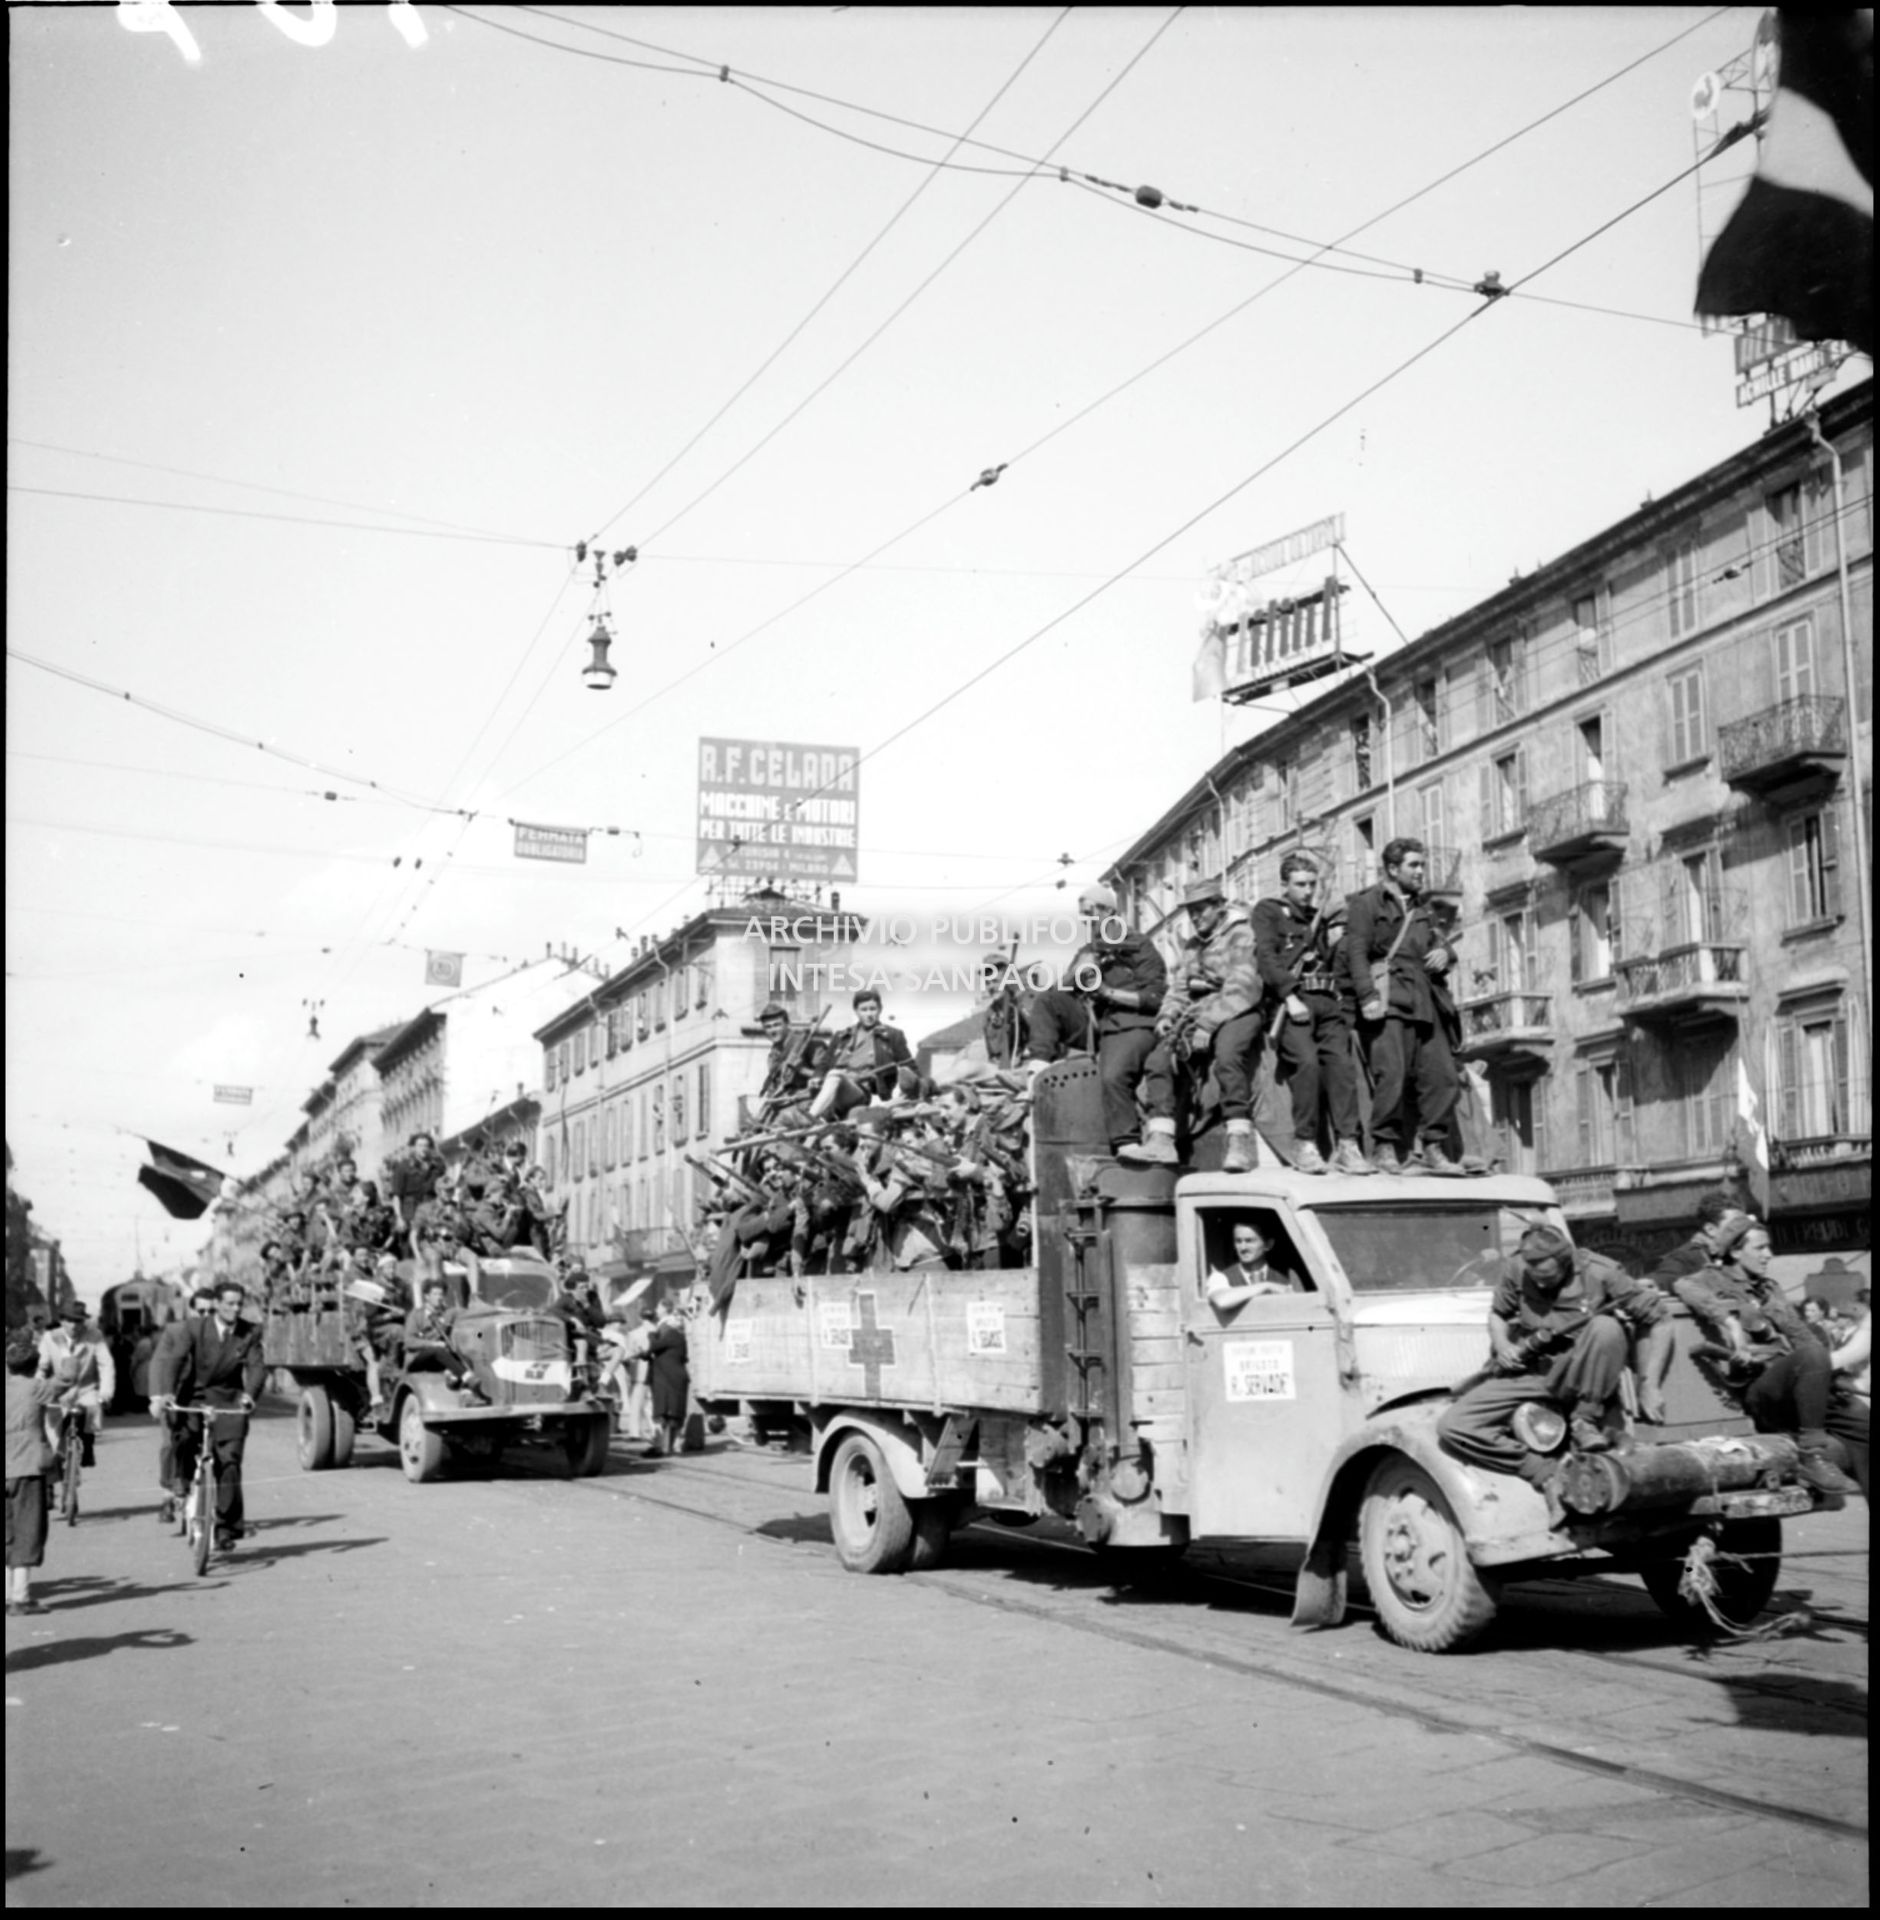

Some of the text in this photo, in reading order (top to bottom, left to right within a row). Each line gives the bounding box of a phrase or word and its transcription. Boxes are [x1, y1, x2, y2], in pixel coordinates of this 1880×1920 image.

[518, 827, 584, 846] FERMATA
[700, 819, 725, 840] PER
[771, 823, 787, 843] LE
[792, 825, 856, 849] INDUSTRIE
